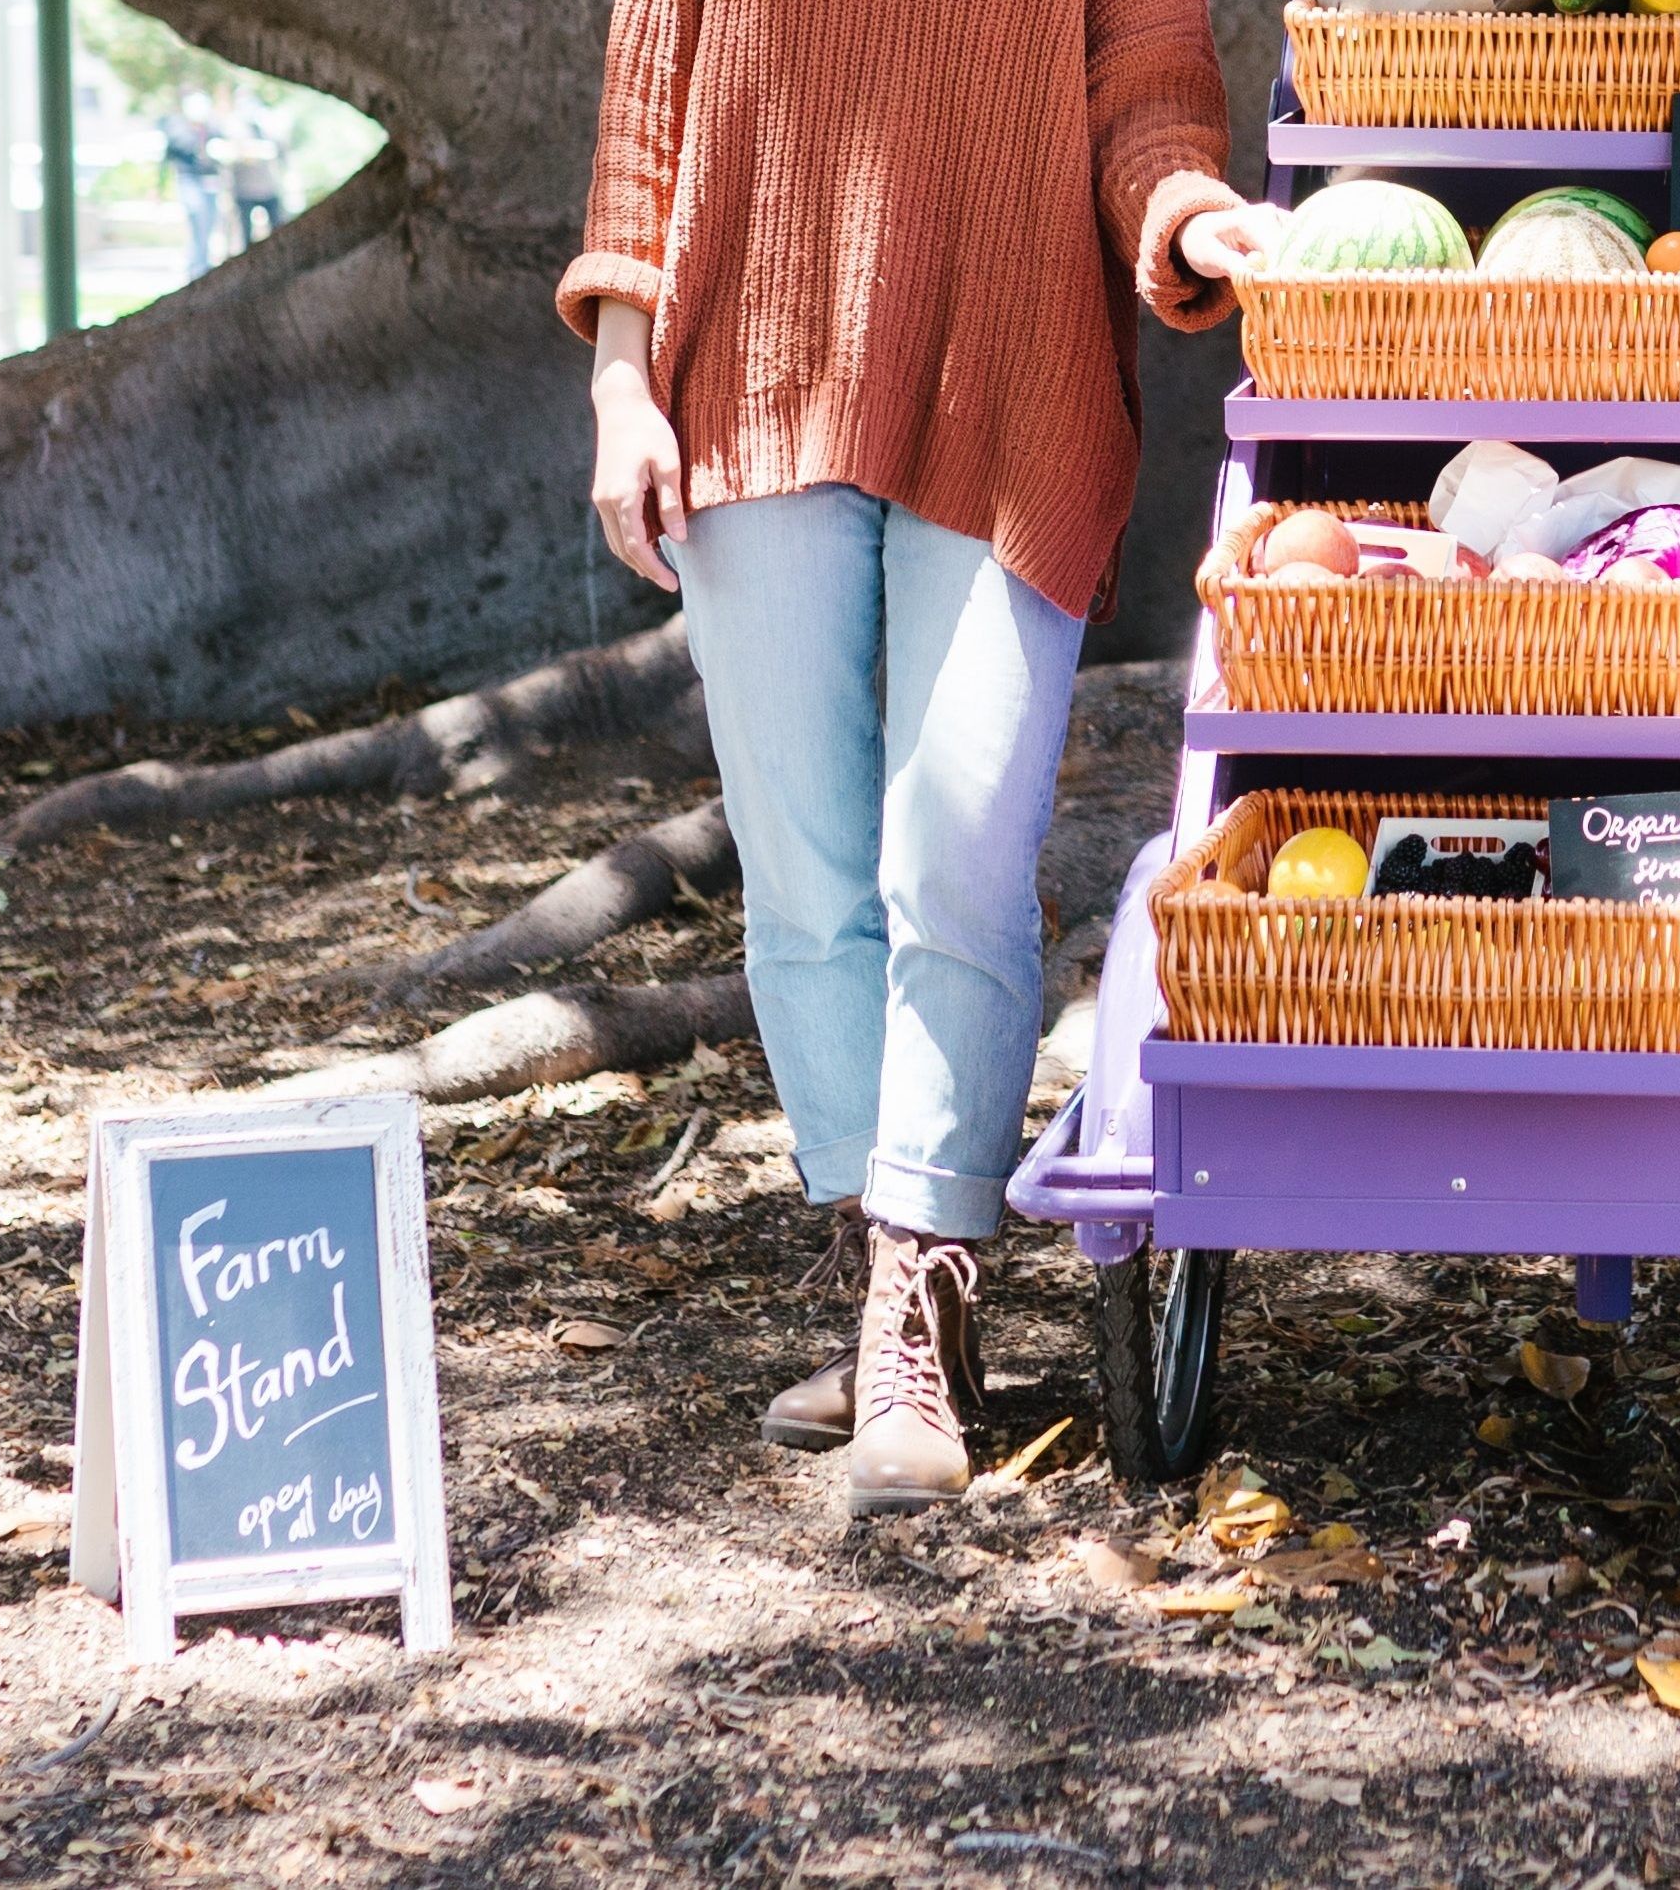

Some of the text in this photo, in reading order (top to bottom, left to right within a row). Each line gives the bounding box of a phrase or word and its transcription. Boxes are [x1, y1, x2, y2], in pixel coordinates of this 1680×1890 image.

[178, 1198, 345, 1318] Farm
[175, 1281, 354, 1470] Stand
[238, 1471, 382, 1550] open all day
